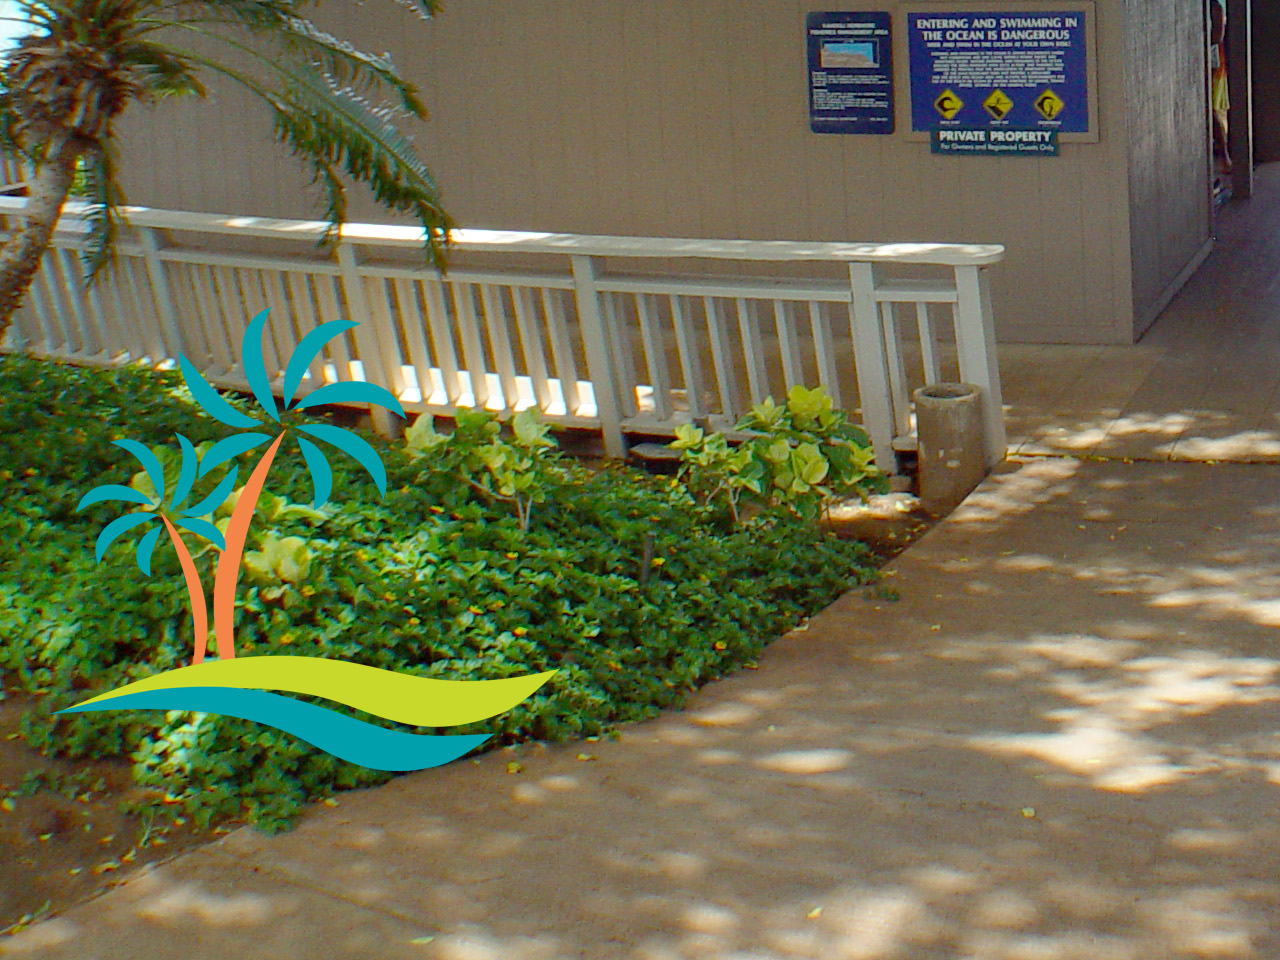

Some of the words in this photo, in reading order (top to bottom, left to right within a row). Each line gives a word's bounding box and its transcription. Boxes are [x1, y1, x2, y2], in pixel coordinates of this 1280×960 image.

[916, 18, 969, 29] ENTERING
[972, 18, 996, 28] AND
[1000, 17, 1062, 28] SWIMMING
[1065, 17, 1078, 28] IN
[922, 30, 943, 40] THE
[945, 30, 984, 40] OCEAN
[987, 30, 998, 40] IS
[1000, 29, 1070, 40] DANGEROUS
[939, 130, 985, 141] PRIVATE
[990, 131, 1051, 142] PROPERTY
[1039, 143, 1054, 152] Only
